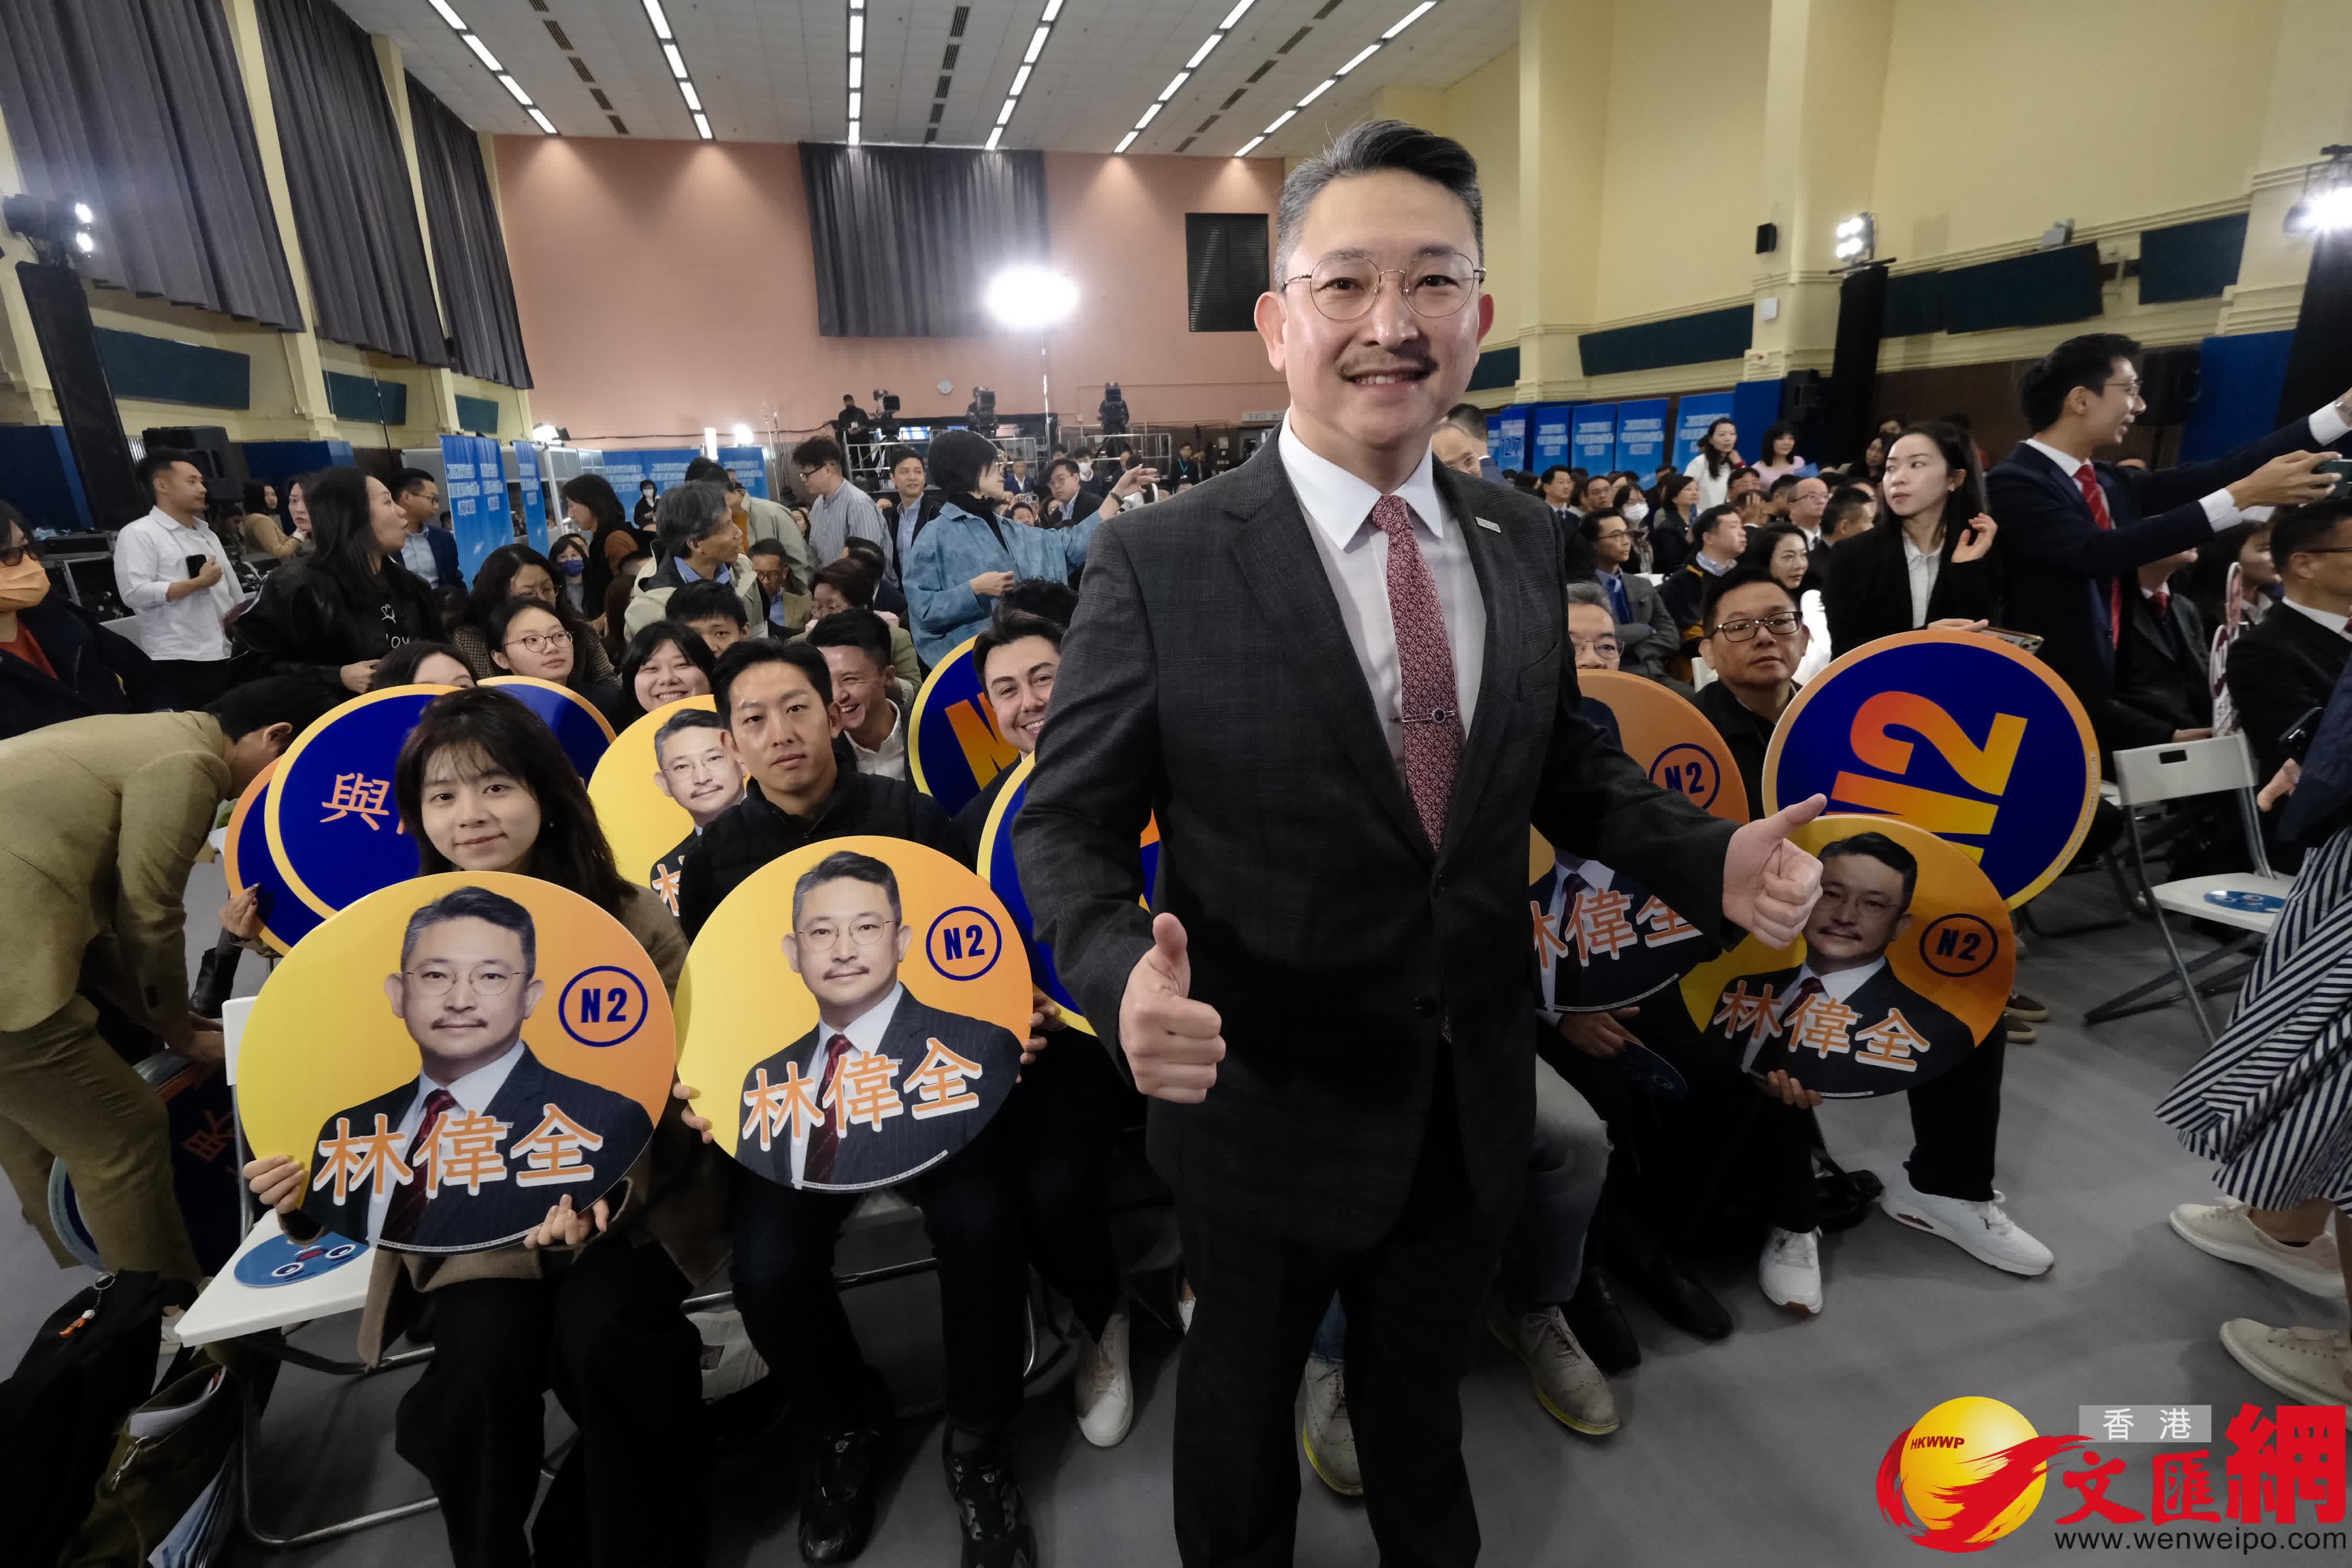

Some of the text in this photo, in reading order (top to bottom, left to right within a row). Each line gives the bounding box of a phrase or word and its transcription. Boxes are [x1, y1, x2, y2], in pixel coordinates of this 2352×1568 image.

[1664, 762, 1704, 794] N2
[320, 773, 404, 835] 與
[944, 924, 985, 961] N2
[1936, 928, 1981, 961] N2
[581, 987, 627, 1024] N2
[1713, 979, 1931, 1072] 林偉全
[742, 1037, 983, 1152] 林偉全
[313, 1103, 604, 1206] 林偉全
